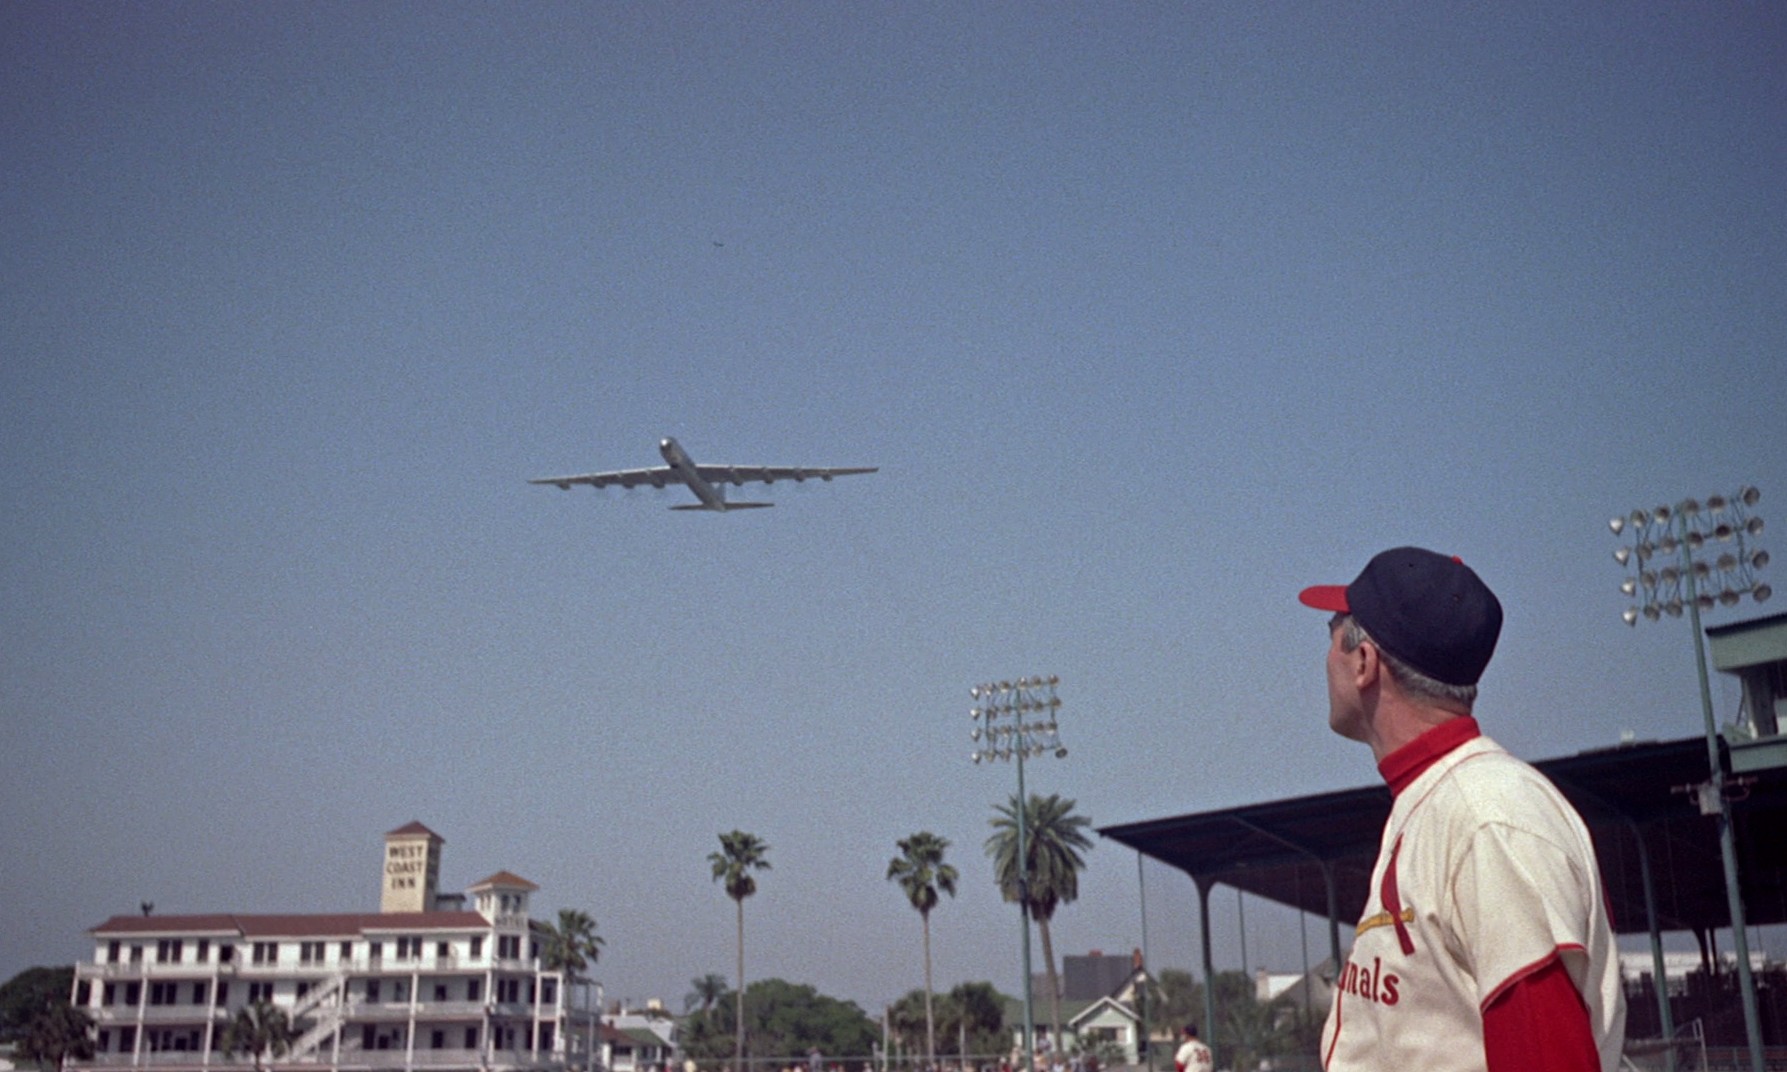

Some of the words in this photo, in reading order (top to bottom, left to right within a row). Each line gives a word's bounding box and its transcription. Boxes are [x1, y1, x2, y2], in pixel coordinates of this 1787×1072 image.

[389, 845, 423, 858] WEST
[386, 861, 422, 874] COAST
[391, 877, 416, 889] INN
